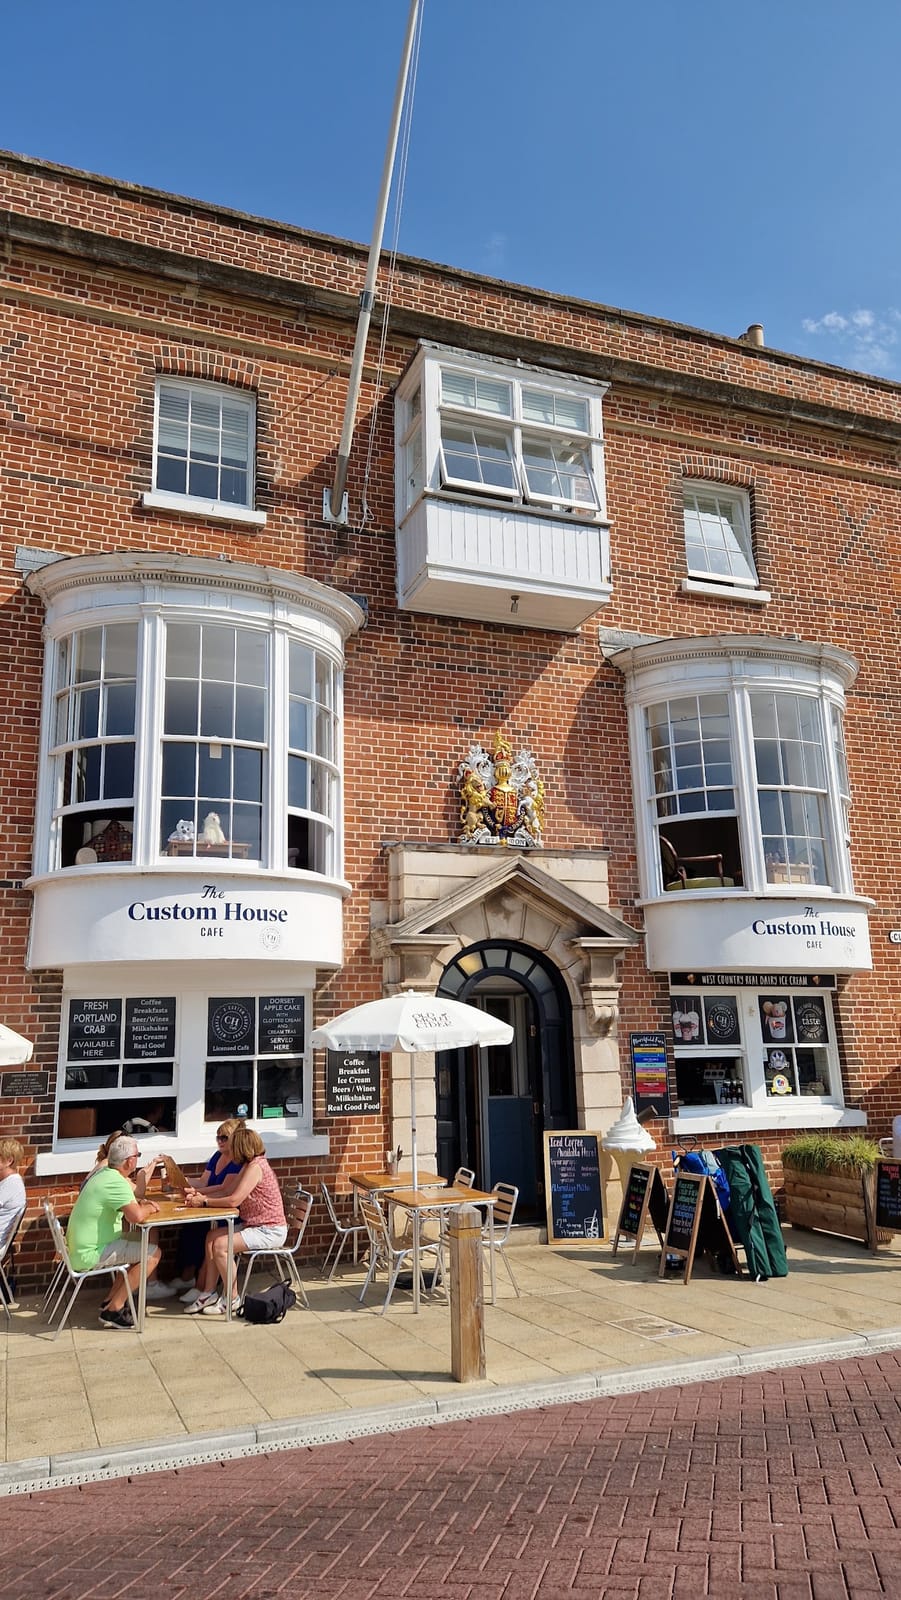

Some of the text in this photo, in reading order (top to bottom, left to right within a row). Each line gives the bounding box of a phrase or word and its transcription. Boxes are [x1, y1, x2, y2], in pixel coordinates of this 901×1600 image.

[201, 885, 225, 899] The
[128, 902, 288, 922] Custom House
[804, 907, 819, 918] The
[200, 927, 224, 937] CAFE
[752, 919, 856, 937] Custom House
[806, 941, 822, 949] CAFE
[702, 975, 808, 985] WEST COUNTRY REAL DAIRY ICE CREAM
[83, 1001, 109, 1011] FRESH
[73, 1013, 117, 1023] PORTLAND
[84, 1025, 106, 1034] CRAB
[344, 1058, 365, 1066] Coffee
[348, 1076, 371, 1084] Cream
[336, 1094, 372, 1102] Milkshakes
[328, 1104, 343, 1112] Real
[364, 1102, 380, 1110] Food
[550, 1136, 584, 1150] Iced Coffee
